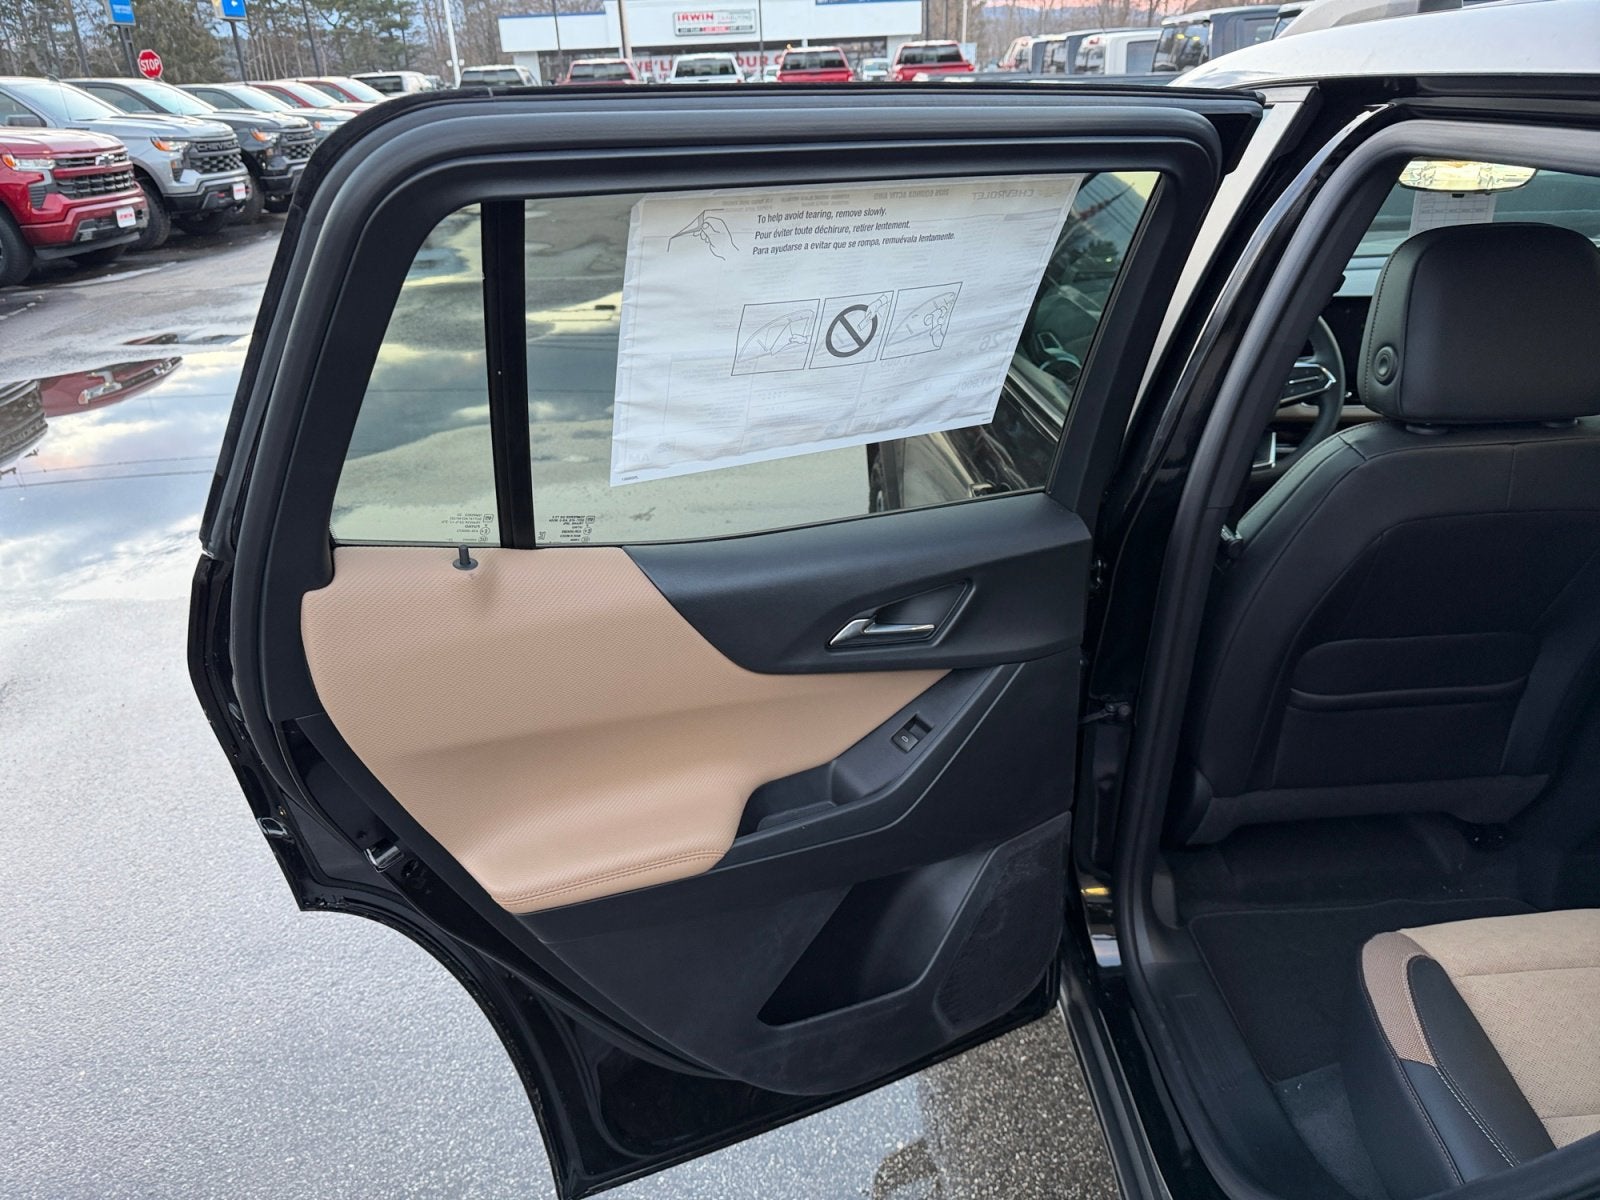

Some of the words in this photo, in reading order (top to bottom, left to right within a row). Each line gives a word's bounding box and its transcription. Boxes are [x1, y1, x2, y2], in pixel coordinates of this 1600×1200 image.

[677, 13, 714, 21] IRWIN
[140, 58, 161, 71] STOP
[757, 214, 766, 224] To
[767, 212, 783, 223] help
[784, 210, 804, 221] avoid
[805, 209, 834, 220] tearing,
[835, 209, 862, 218] remove
[863, 206, 887, 217] slowly.
[754, 230, 772, 240] Pour
[773, 229, 793, 239] éviter
[794, 226, 813, 236] toute
[814, 224, 851, 235] déchirure,
[852, 223, 874, 233] retirer
[875, 220, 911, 231] lentement.
[752, 246, 769, 255] Para
[770, 243, 803, 255] ayudarse
[810, 240, 832, 249] evitar
[832, 240, 847, 250] que
[848, 240, 857, 248] se
[857, 237, 881, 248] rompa,
[918, 231, 956, 243] lentamente.
